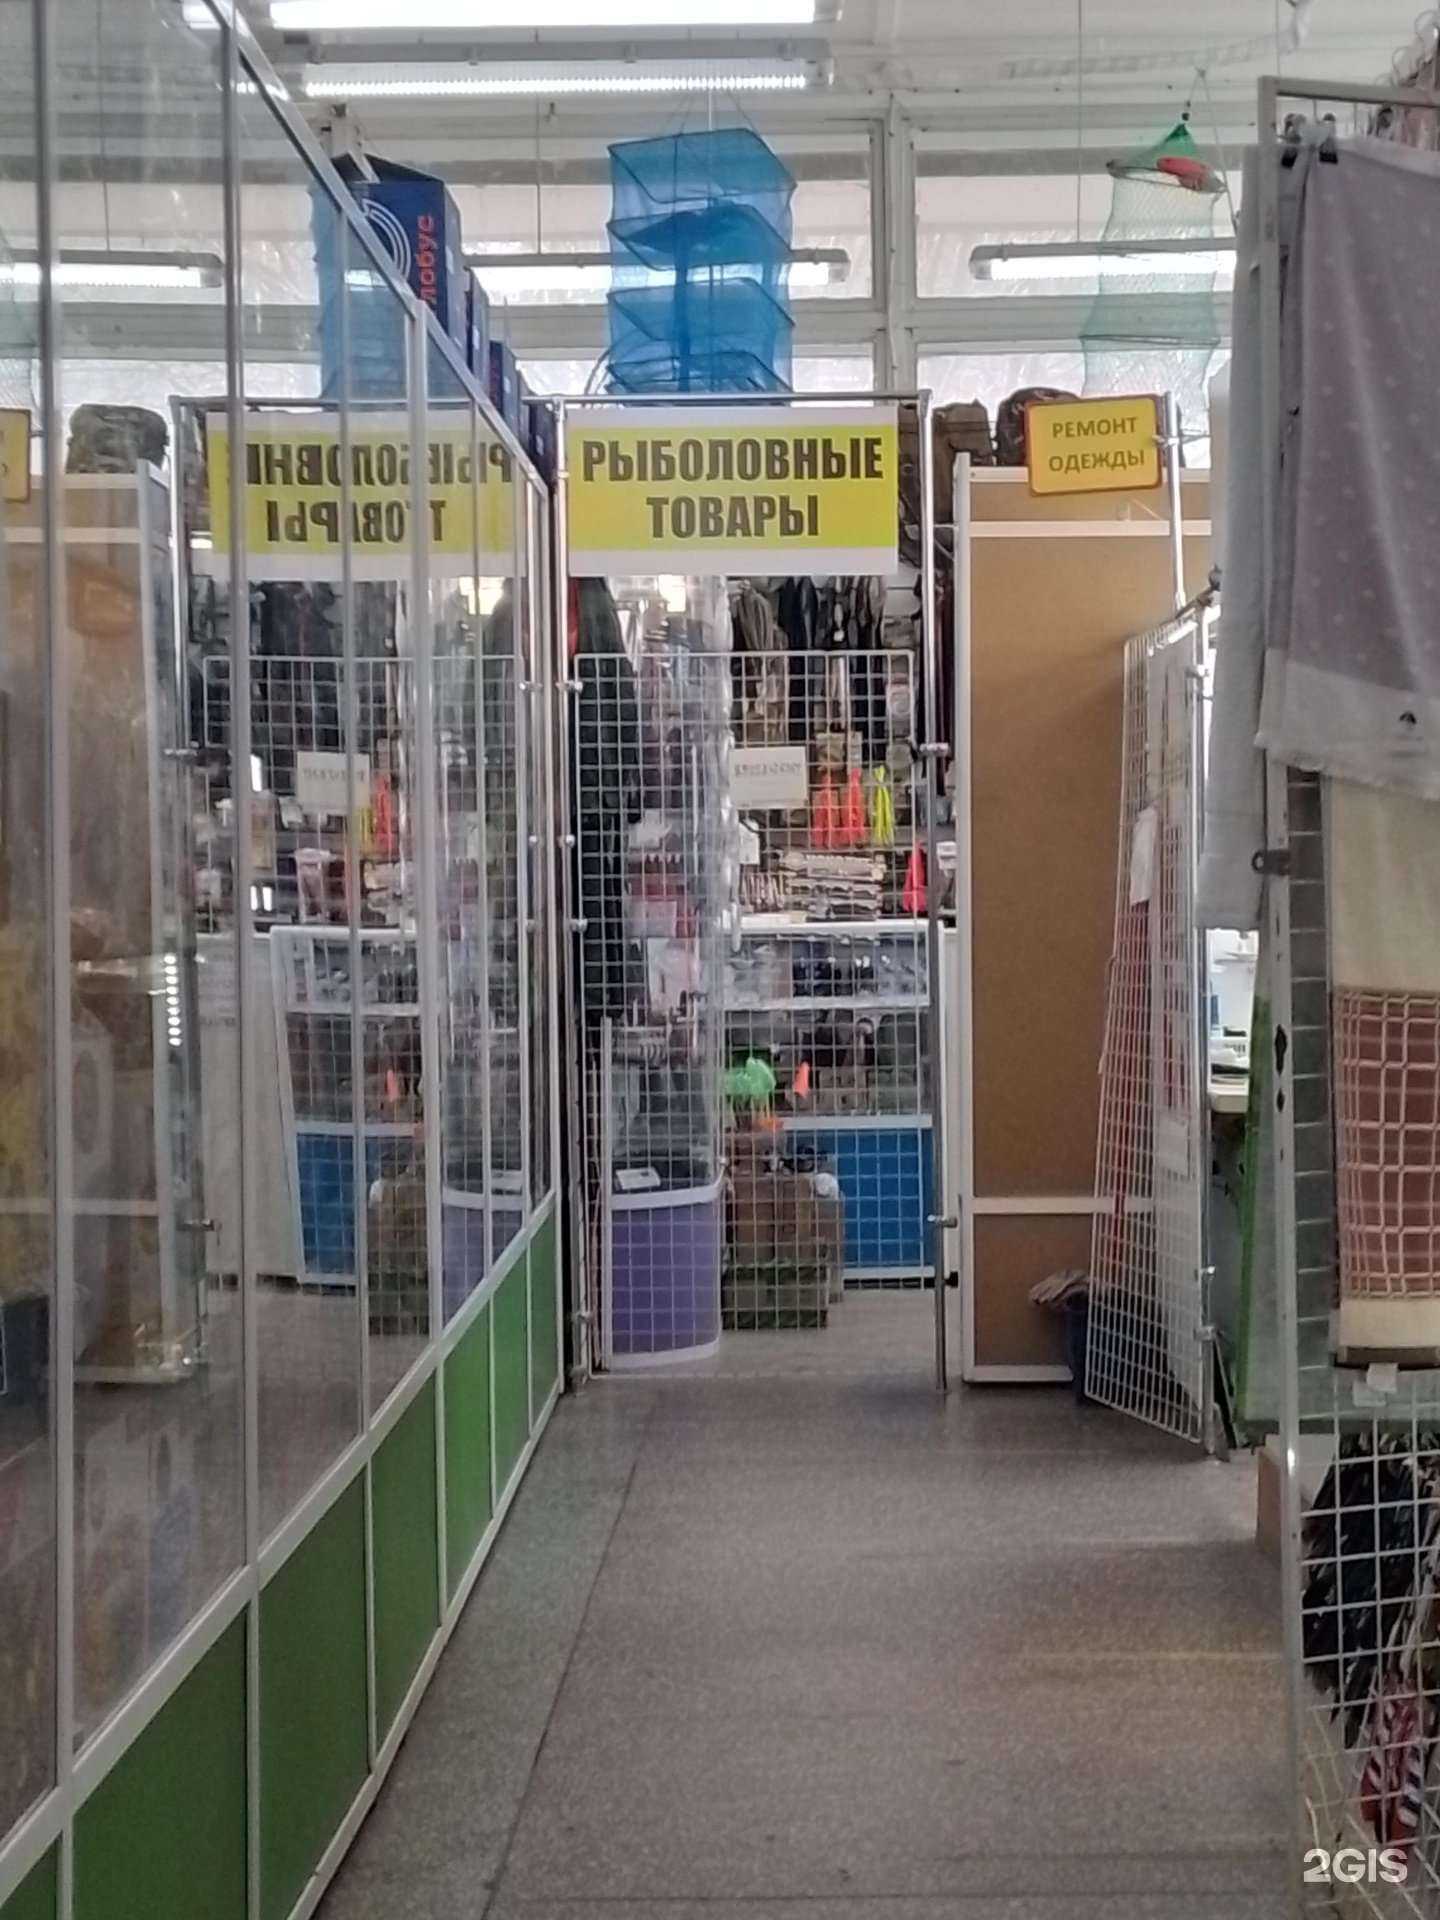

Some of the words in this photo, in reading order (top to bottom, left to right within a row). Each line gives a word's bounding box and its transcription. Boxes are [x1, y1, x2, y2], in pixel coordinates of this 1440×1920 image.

[414, 214, 437, 305] лобус
[1052, 416, 1137, 438] РЕМОНТ
[582, 437, 884, 482] РЫБОЛОВНЫЕ
[1048, 449, 1145, 475] ОДЕЖДЫ
[646, 495, 819, 538] ТОВАРЫ
